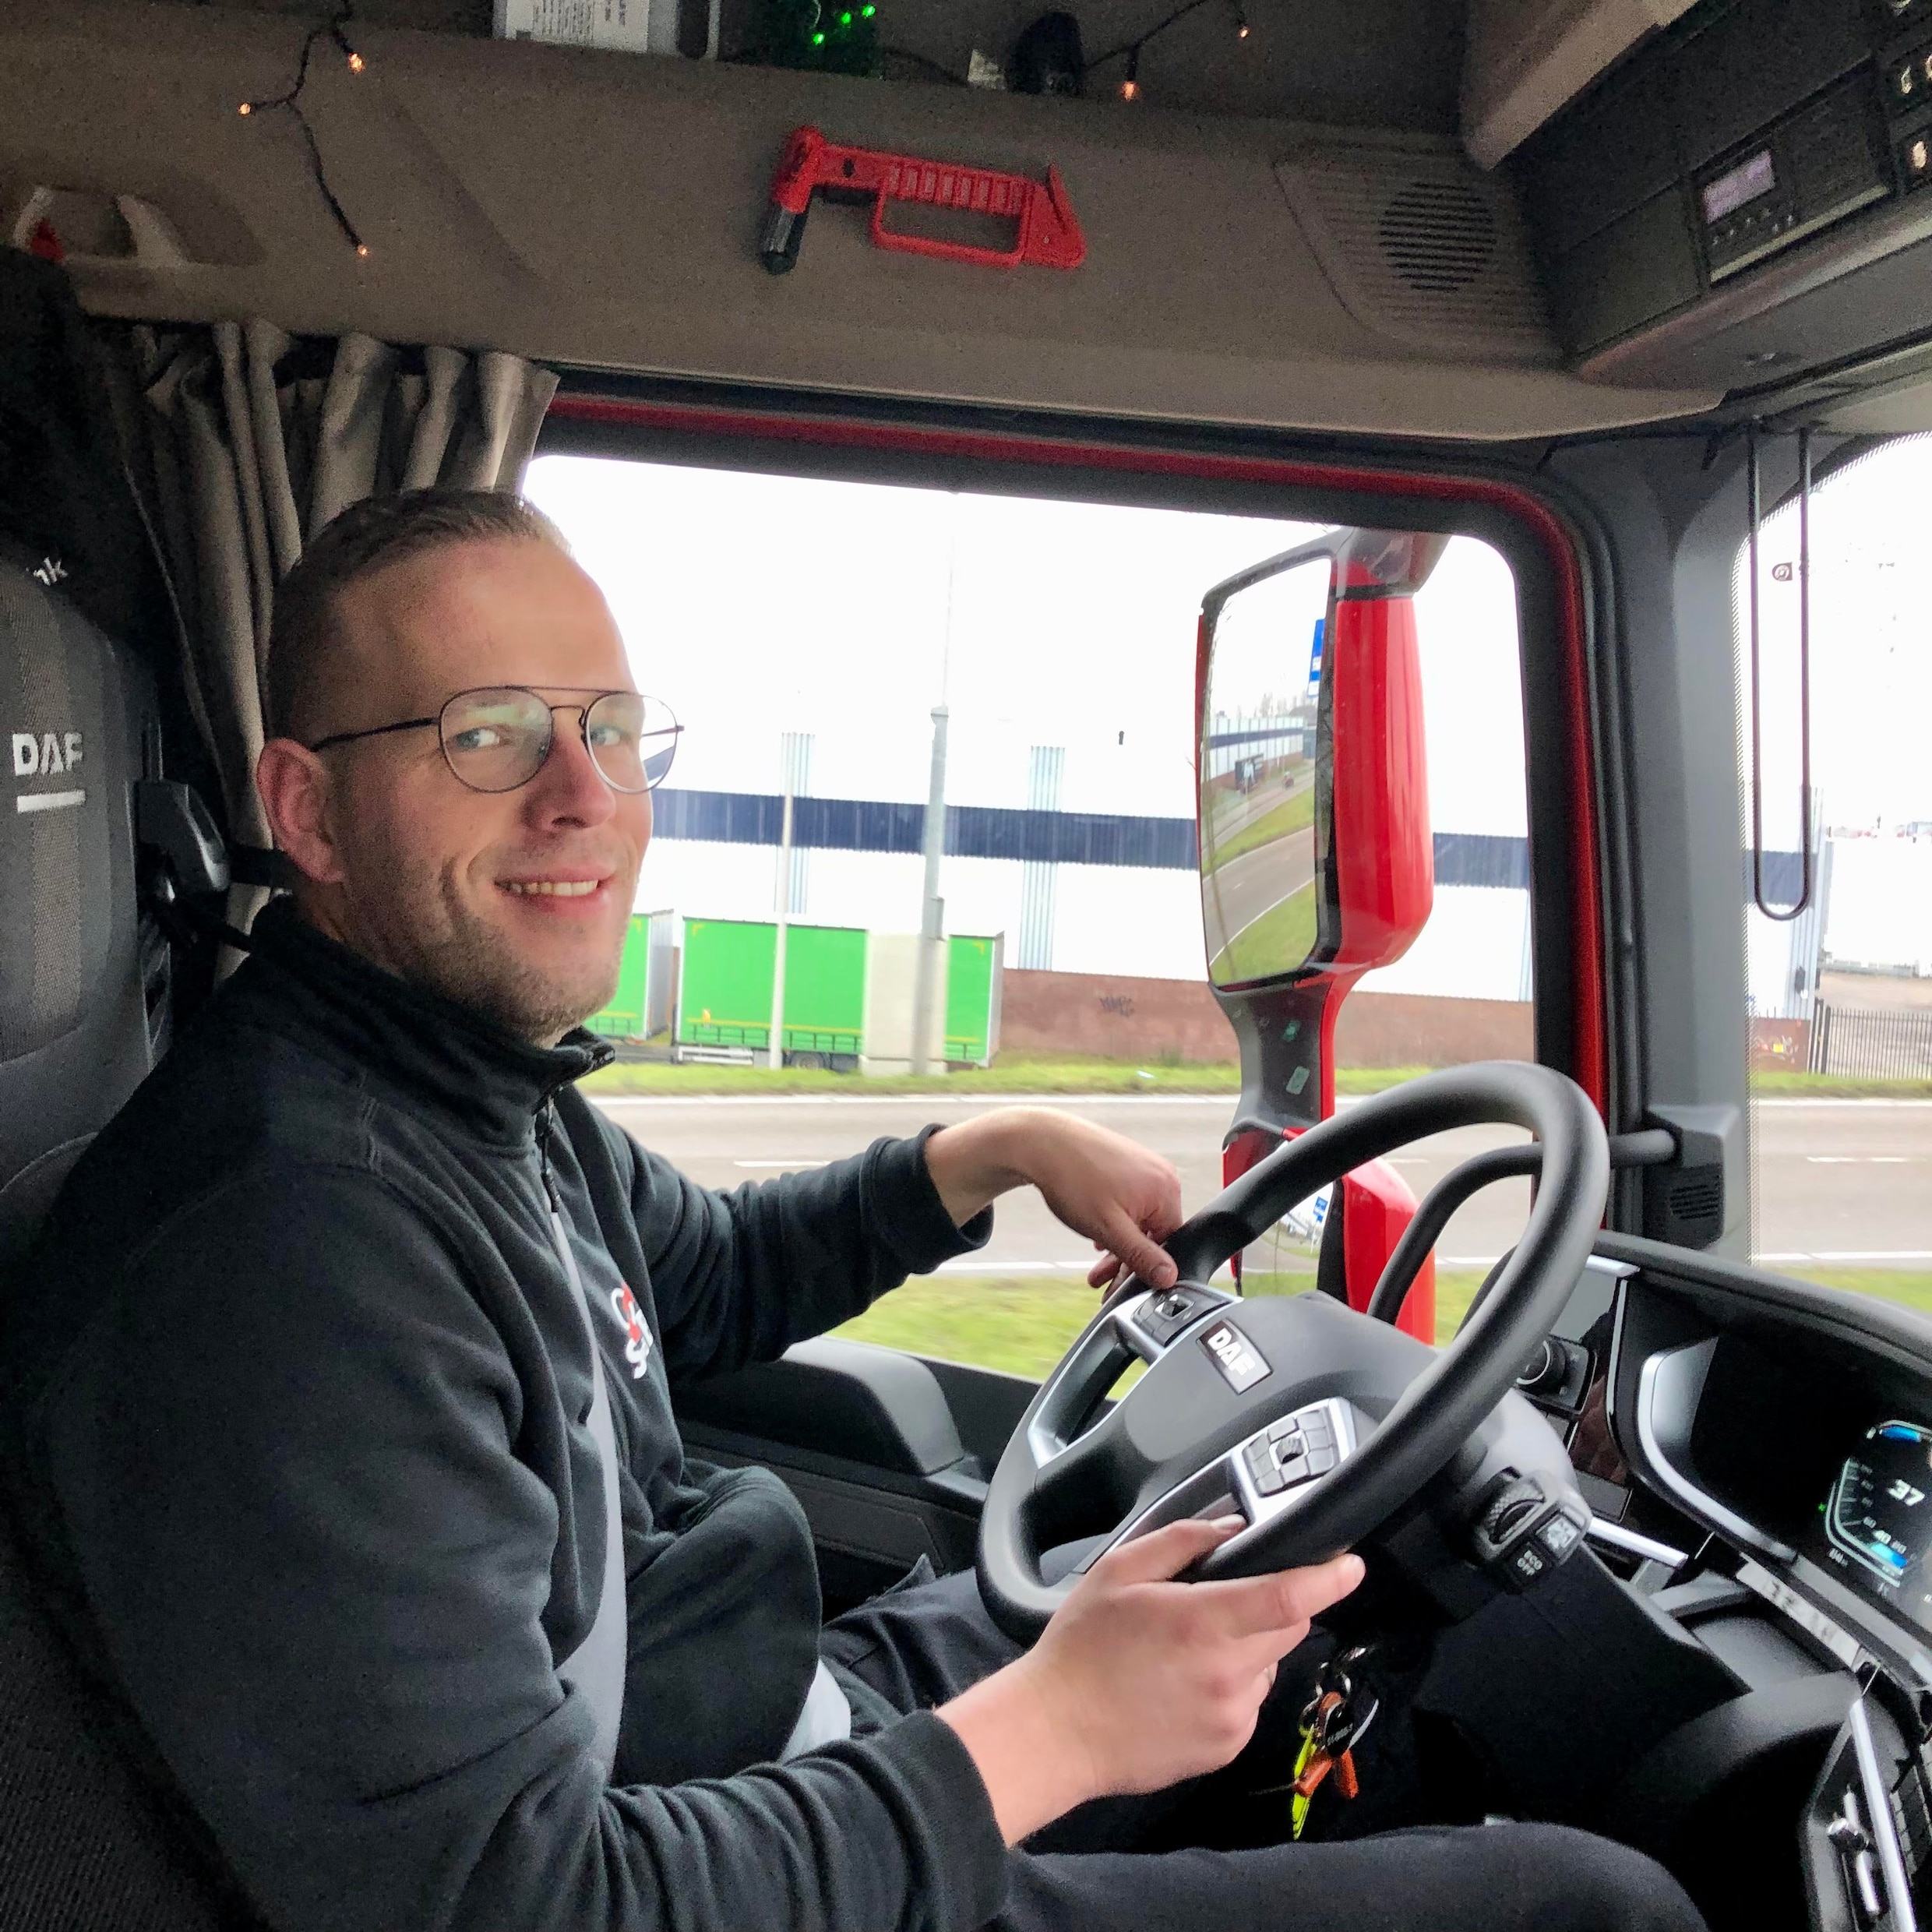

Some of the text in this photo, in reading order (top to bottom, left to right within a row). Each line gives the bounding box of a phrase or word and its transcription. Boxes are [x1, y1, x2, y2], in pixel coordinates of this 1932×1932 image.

[12, 732, 83, 776] DAF
[1208, 1327, 1255, 1376] DAF
[1887, 1479, 1925, 1506] 37
